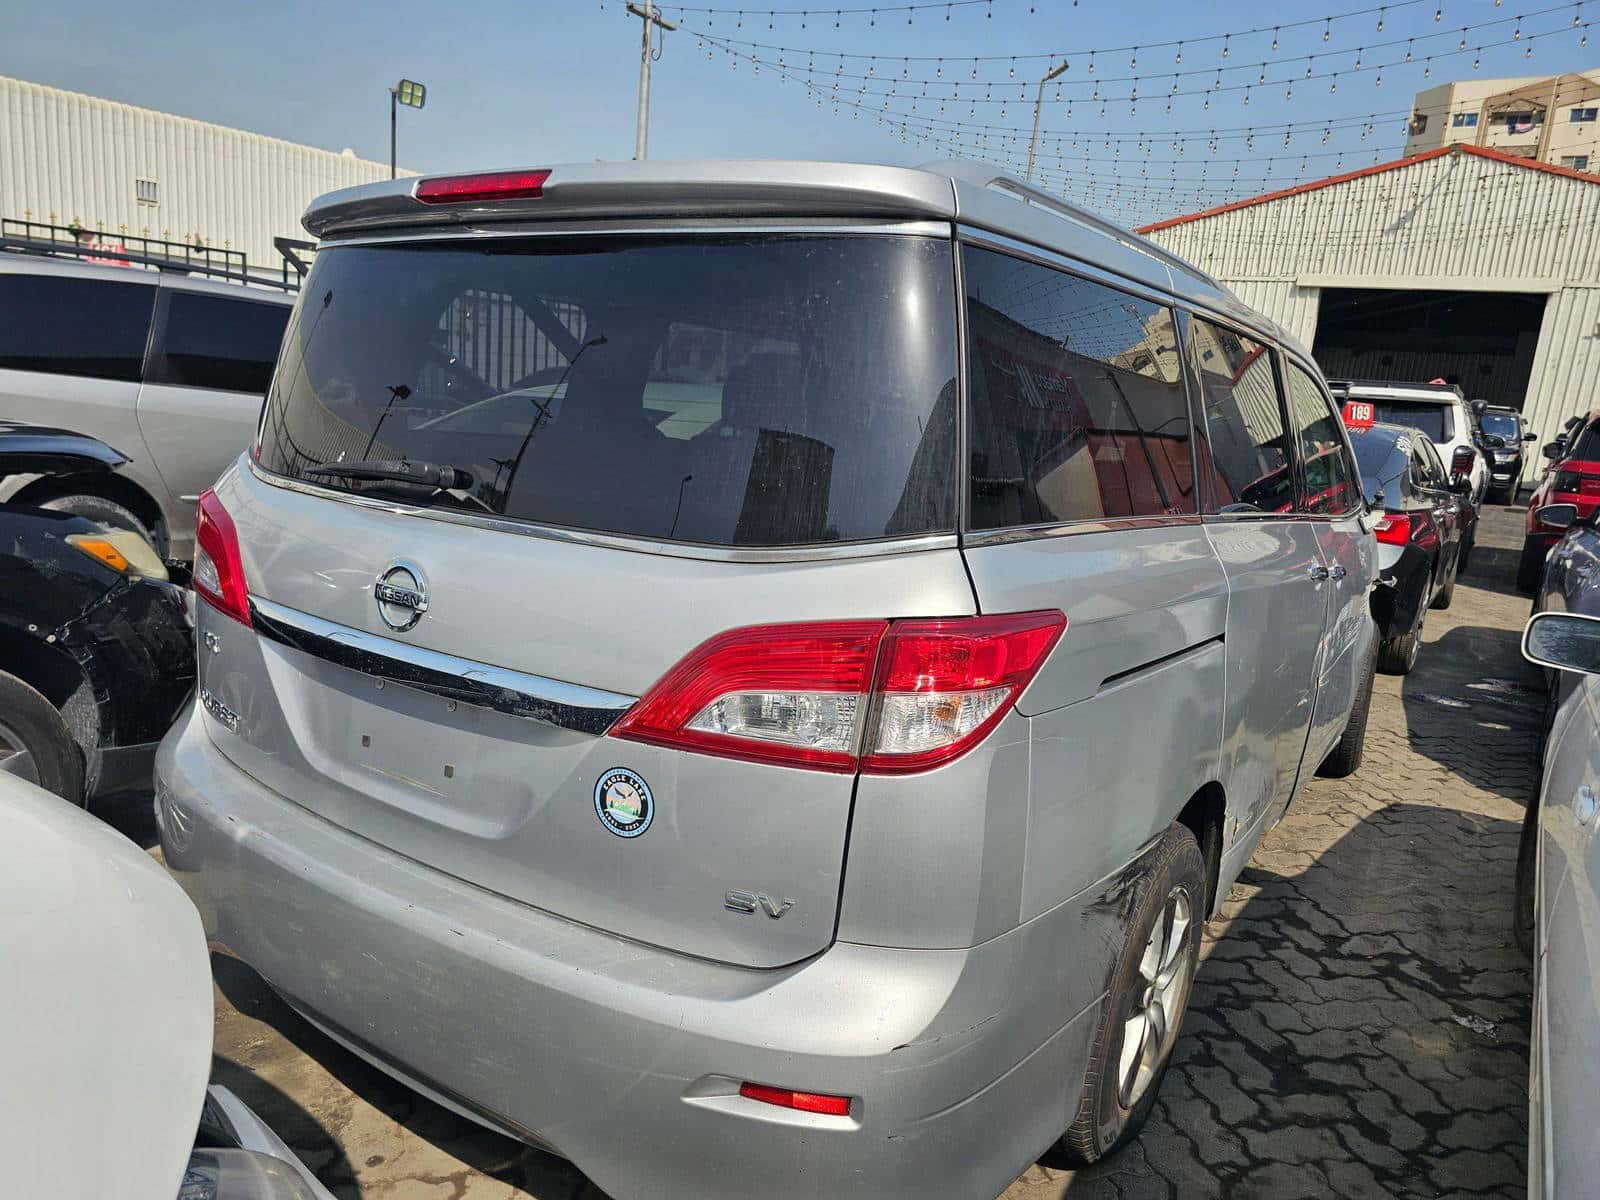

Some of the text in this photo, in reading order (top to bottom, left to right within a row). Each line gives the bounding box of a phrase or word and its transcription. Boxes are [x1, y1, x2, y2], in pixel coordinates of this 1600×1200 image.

[1351, 405, 1370, 420] 189
[375, 583, 422, 608] NISSAN
[603, 775, 646, 801] EAGLE LAKE
[724, 888, 796, 919] SV
